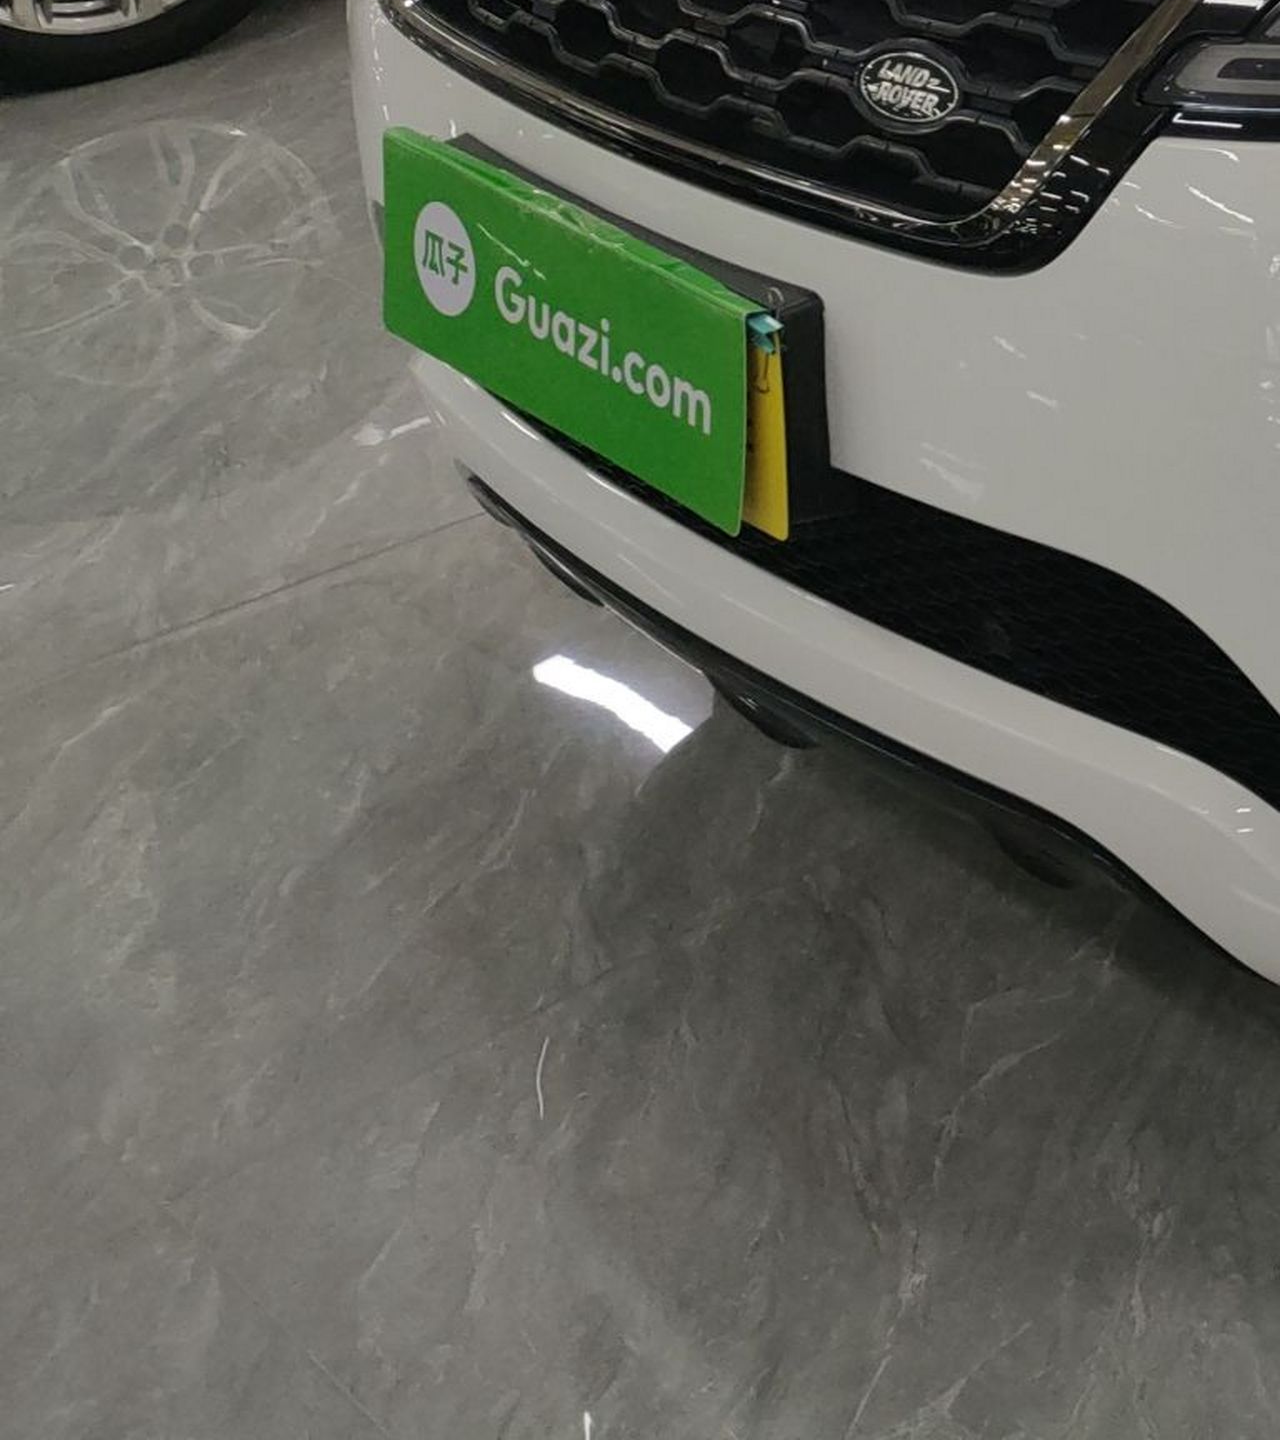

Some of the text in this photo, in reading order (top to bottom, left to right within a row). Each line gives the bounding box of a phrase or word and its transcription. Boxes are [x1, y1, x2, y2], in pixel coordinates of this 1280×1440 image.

[878, 60, 931, 88] LAND
[879, 81, 939, 114] ROVER
[421, 230, 468, 286] 瓜子
[494, 266, 711, 435] Guazi.com
